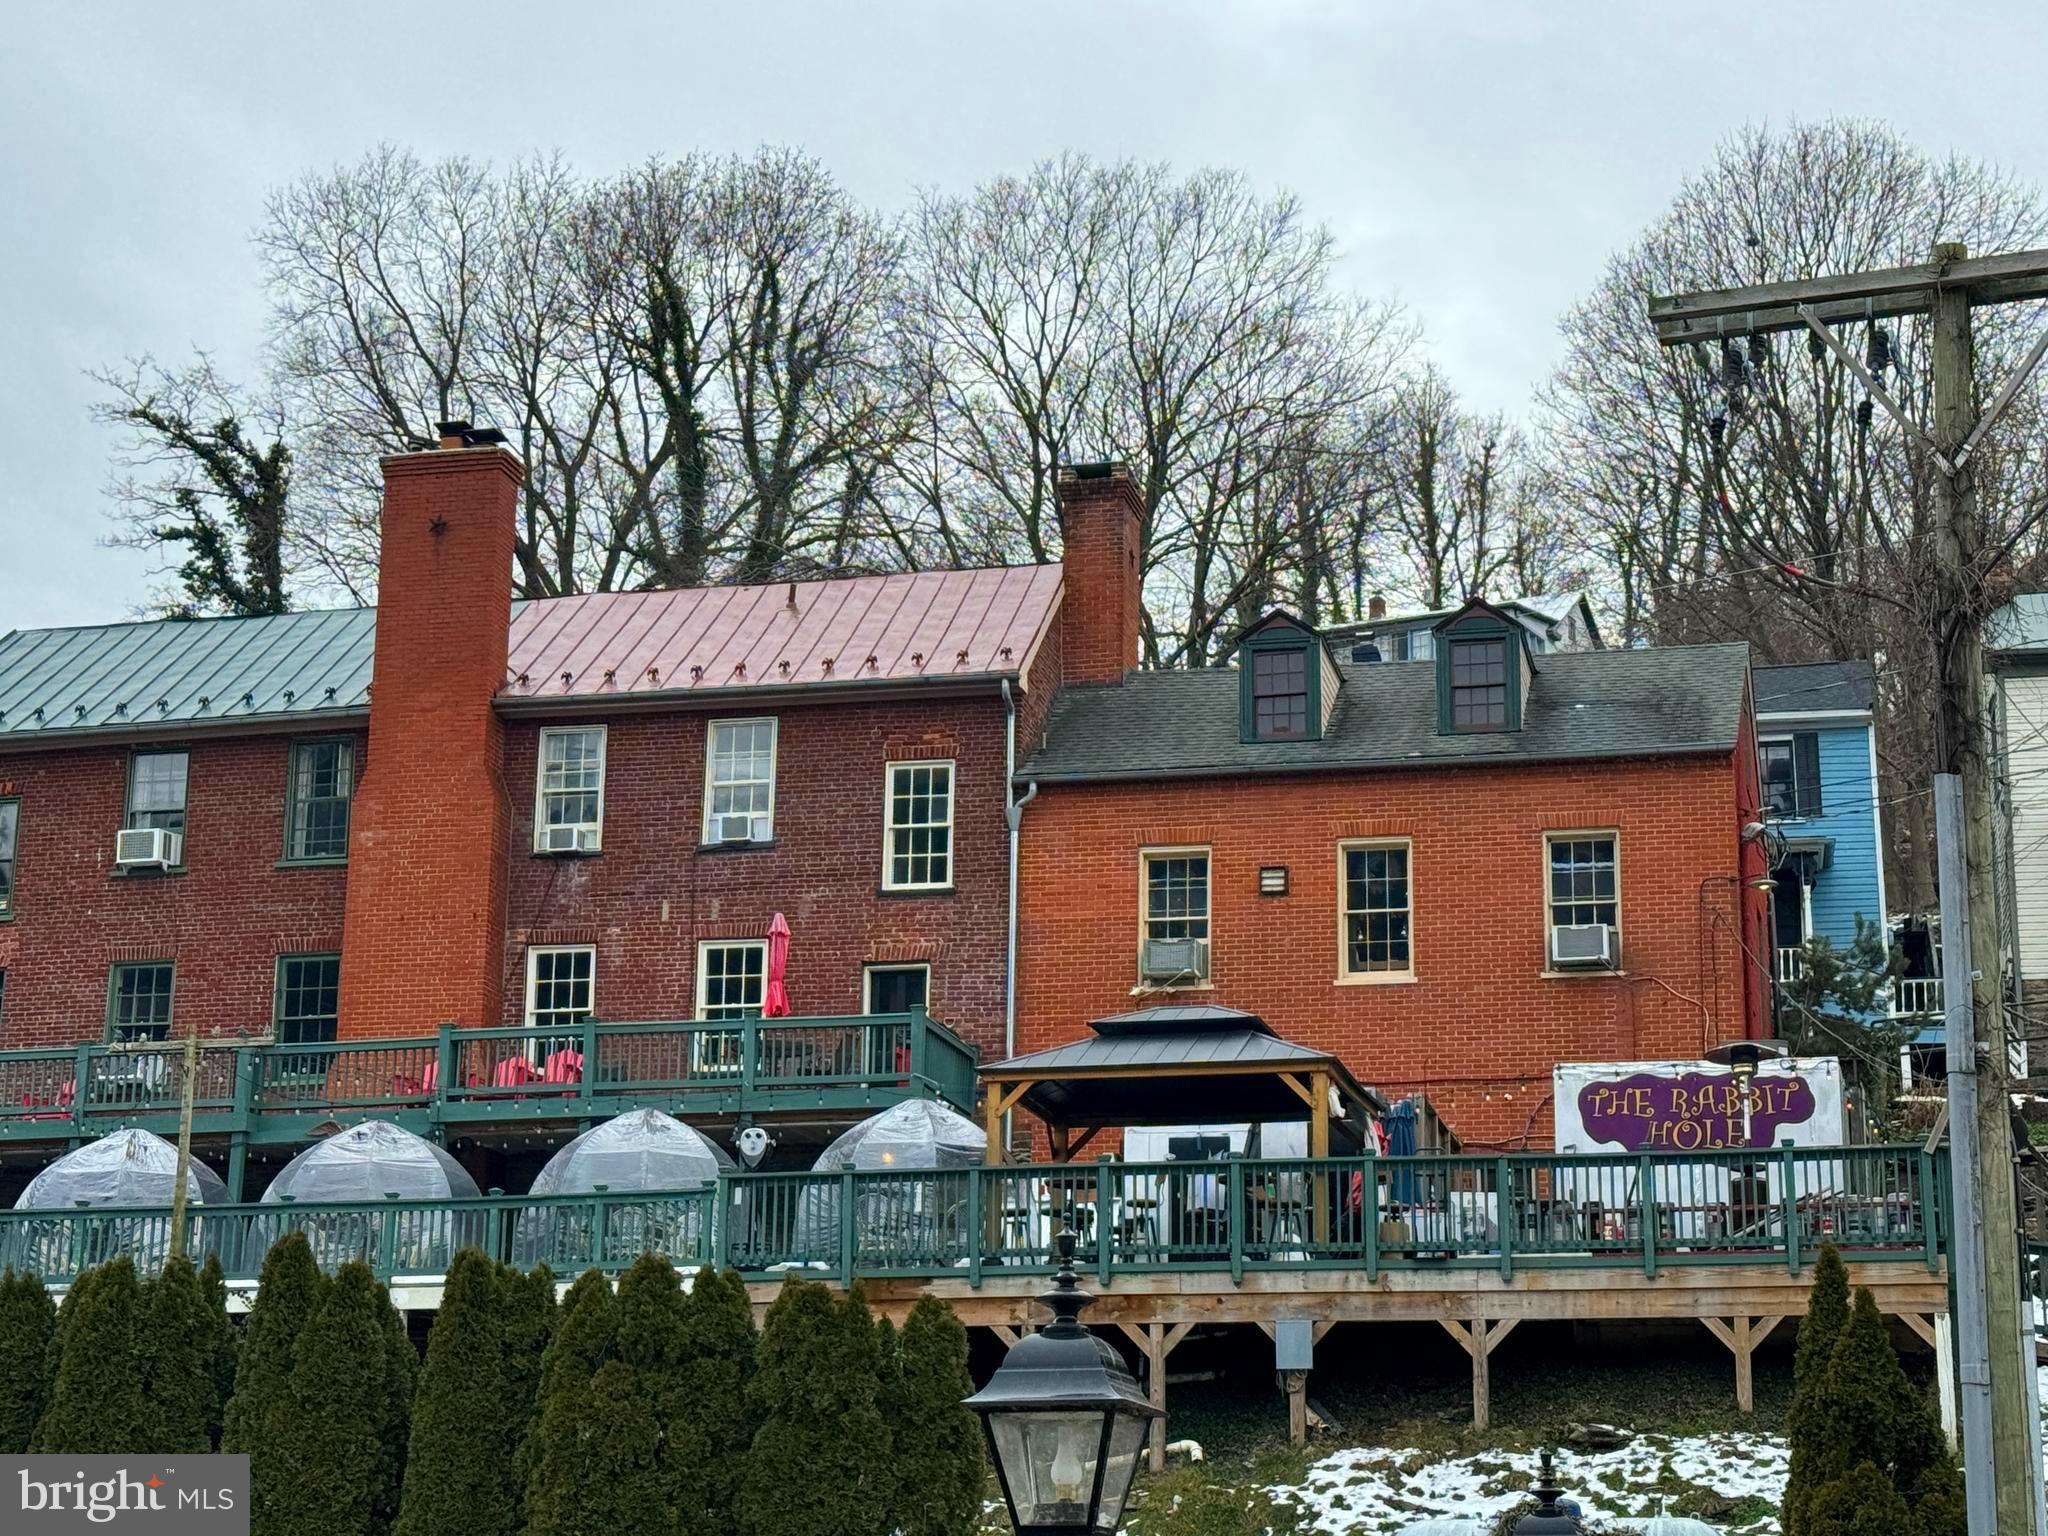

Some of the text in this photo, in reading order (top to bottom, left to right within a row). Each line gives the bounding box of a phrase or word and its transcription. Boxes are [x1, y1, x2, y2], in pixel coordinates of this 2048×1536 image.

[1588, 1082, 1800, 1119] THE RABBIT
[1649, 1118, 1746, 1150] HOLE
